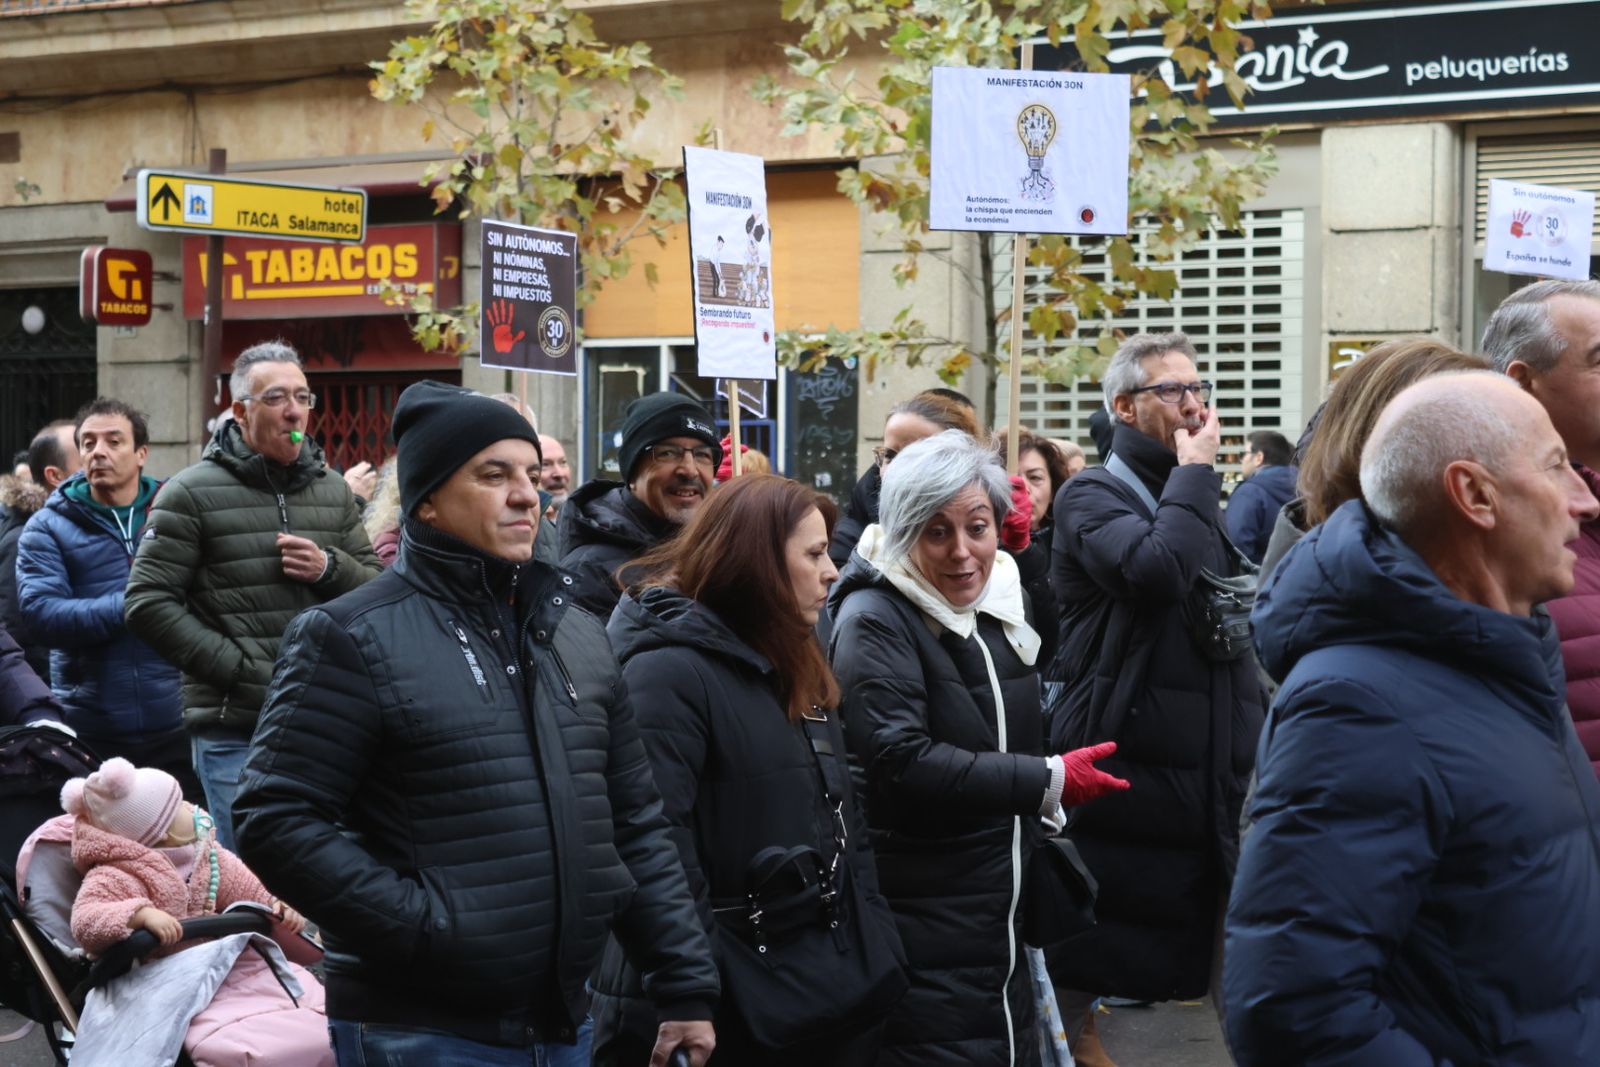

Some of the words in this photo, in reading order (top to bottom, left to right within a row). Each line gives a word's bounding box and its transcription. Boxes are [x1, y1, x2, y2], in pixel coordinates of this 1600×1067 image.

[1405, 46, 1570, 87] peluquerías
[986, 77, 1062, 89] MANIFESTACIÓN
[1064, 80, 1083, 90] 30N
[1513, 187, 1526, 197] Sin
[323, 197, 360, 214] hotel
[974, 206, 998, 214] chispa
[999, 207, 1013, 215] que
[1014, 207, 1053, 215] encienden
[237, 210, 279, 228] ITACA
[288, 214, 359, 235] Salamanca
[1546, 217, 1559, 230] 30
[487, 231, 503, 247] SIN
[245, 243, 418, 284] TABACOS
[493, 251, 502, 264] NI
[504, 250, 546, 273] NÓMINAS,
[1506, 250, 1537, 262] España
[1549, 256, 1572, 266] hunde
[493, 267, 502, 281] NI
[503, 268, 551, 289] EMPRESAS,
[493, 283, 502, 297] NI
[503, 285, 552, 303] IMPUESTOS
[100, 302, 147, 315] TABACOS
[700, 307, 733, 319] Sembrando
[733, 308, 752, 320] futuro
[546, 319, 563, 338] 30
